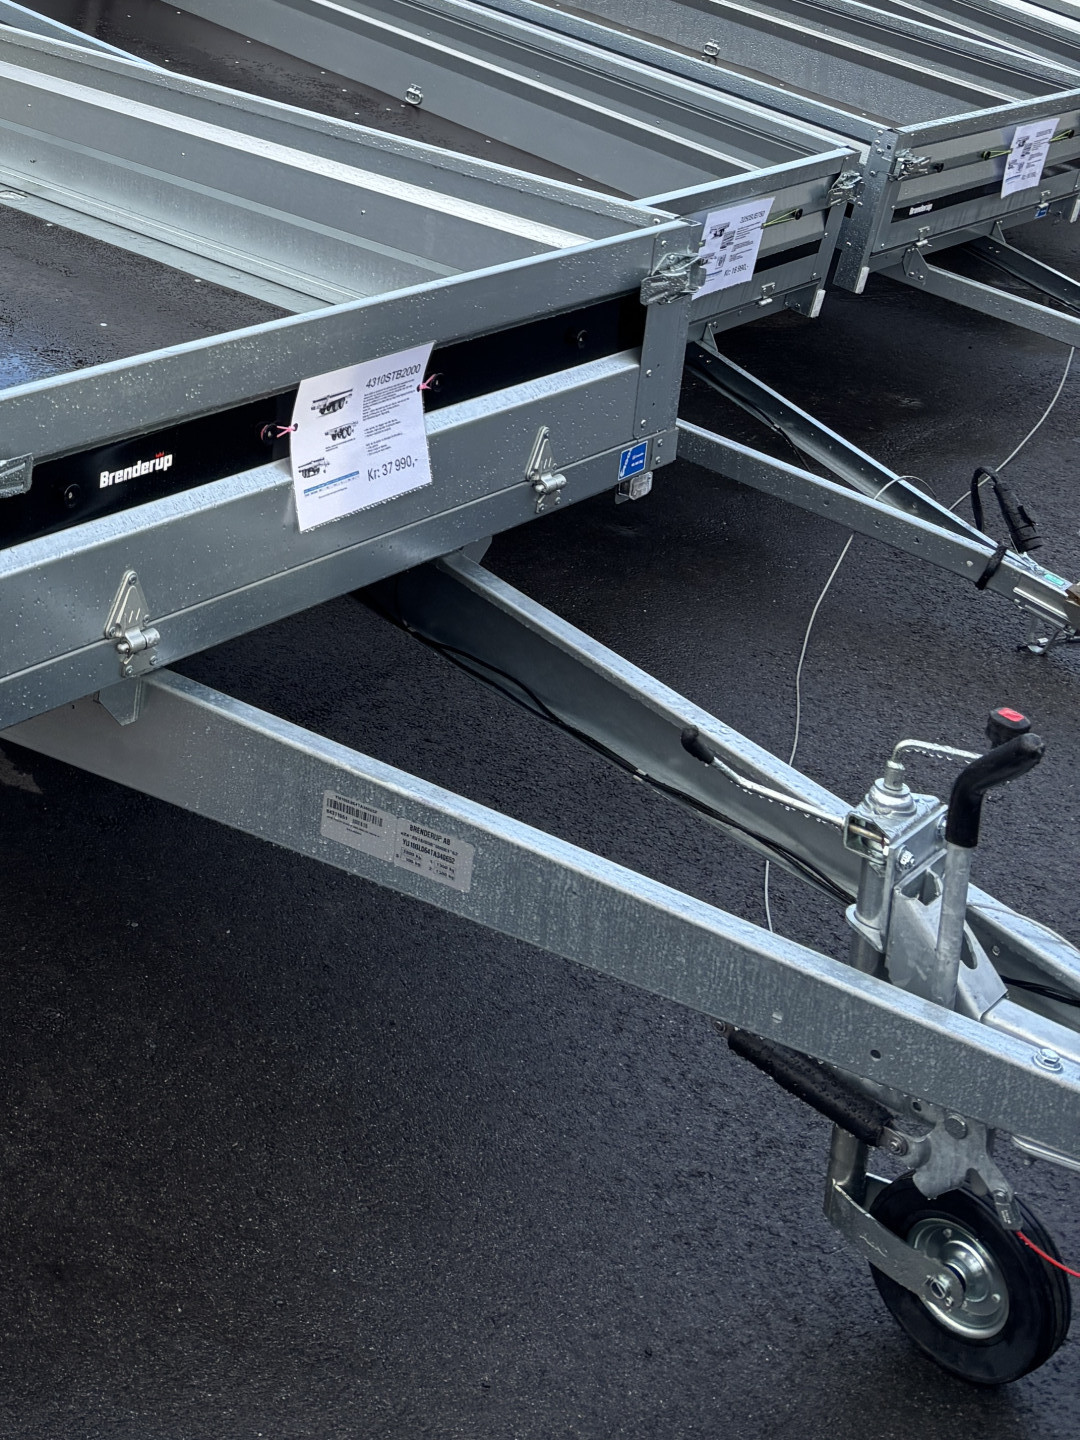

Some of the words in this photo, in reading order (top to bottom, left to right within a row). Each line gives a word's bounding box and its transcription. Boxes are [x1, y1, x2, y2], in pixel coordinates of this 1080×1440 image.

[366, 363, 421, 388] 4310STB2000
[99, 453, 173, 489] Brenderup
[367, 468, 381, 482] Kr:
[381, 461, 393, 476] 37
[394, 455, 419, 472] 990,-
